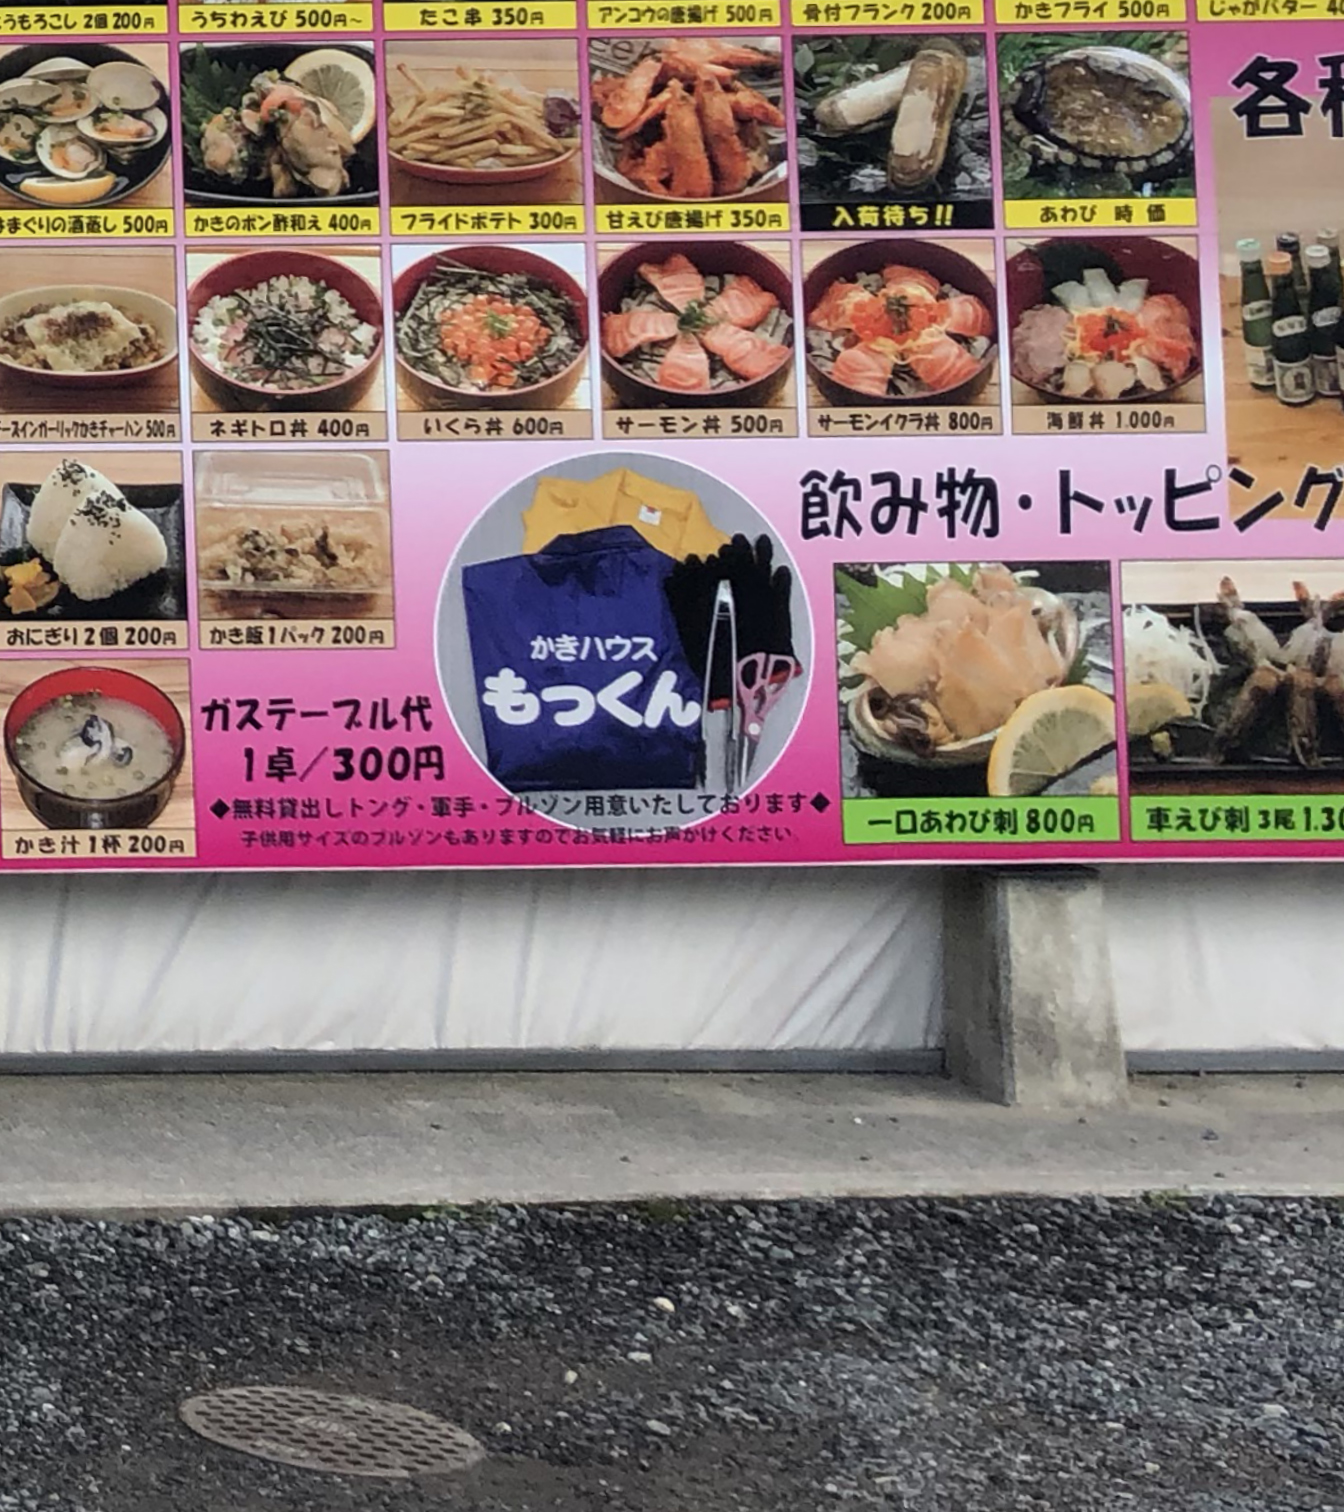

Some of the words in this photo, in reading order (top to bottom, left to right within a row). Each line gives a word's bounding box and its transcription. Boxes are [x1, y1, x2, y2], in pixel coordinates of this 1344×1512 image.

[190, 10, 288, 29] うちわえび
[419, 7, 483, 26] たこ串
[490, 7, 544, 31] 350円
[597, 4, 720, 24] アンコウの唐揚げ
[725, 4, 773, 23] 500円
[801, 3, 915, 22] 骨付フランク
[920, 2, 972, 26] 200円
[1014, 0, 1110, 20] かきフライ
[1117, 0, 1170, 18] 500円
[82, 13, 110, 29] 2個
[112, 12, 155, 30] 200円
[399, 212, 522, 230] フライドポテト
[528, 211, 578, 230] 300円
[605, 209, 724, 230] 甘えび唐揚げ
[729, 209, 782, 228] 350円
[1039, 198, 1097, 223] あわび
[122, 215, 168, 239] 500円
[192, 213, 323, 237] かきのポン酢和え
[327, 213, 373, 237] 400円
[145, 419, 176, 438] 500円
[210, 418, 307, 438] ネギトロ丼
[315, 418, 371, 437] 400円
[422, 417, 503, 436] いくら丼
[511, 417, 564, 436] 600円
[615, 415, 721, 434] サーモン丼
[729, 414, 784, 434] 500円
[817, 412, 942, 432] サーモンイクラ丼
[948, 411, 994, 431] 800円
[1046, 411, 1106, 430] 海鮮丼
[800, 463, 1344, 540] 飲み物・トッピング
[6, 627, 79, 646] おにぎり
[84, 626, 119, 646] 2個
[124, 626, 177, 646] 200円
[209, 625, 325, 645] かき飯1パック
[330, 625, 385, 645] 200円
[530, 634, 657, 662] かきハウス
[201, 694, 433, 733] ガステーブル代
[867, 808, 1019, 836] 一口あわび刺
[1024, 808, 1095, 834] 800円
[1145, 806, 1251, 833] 車えび刺
[1257, 808, 1297, 831] 3尾
[13, 835, 81, 855] かき汁
[87, 834, 122, 854] 1杯
[128, 835, 184, 859] 200円
